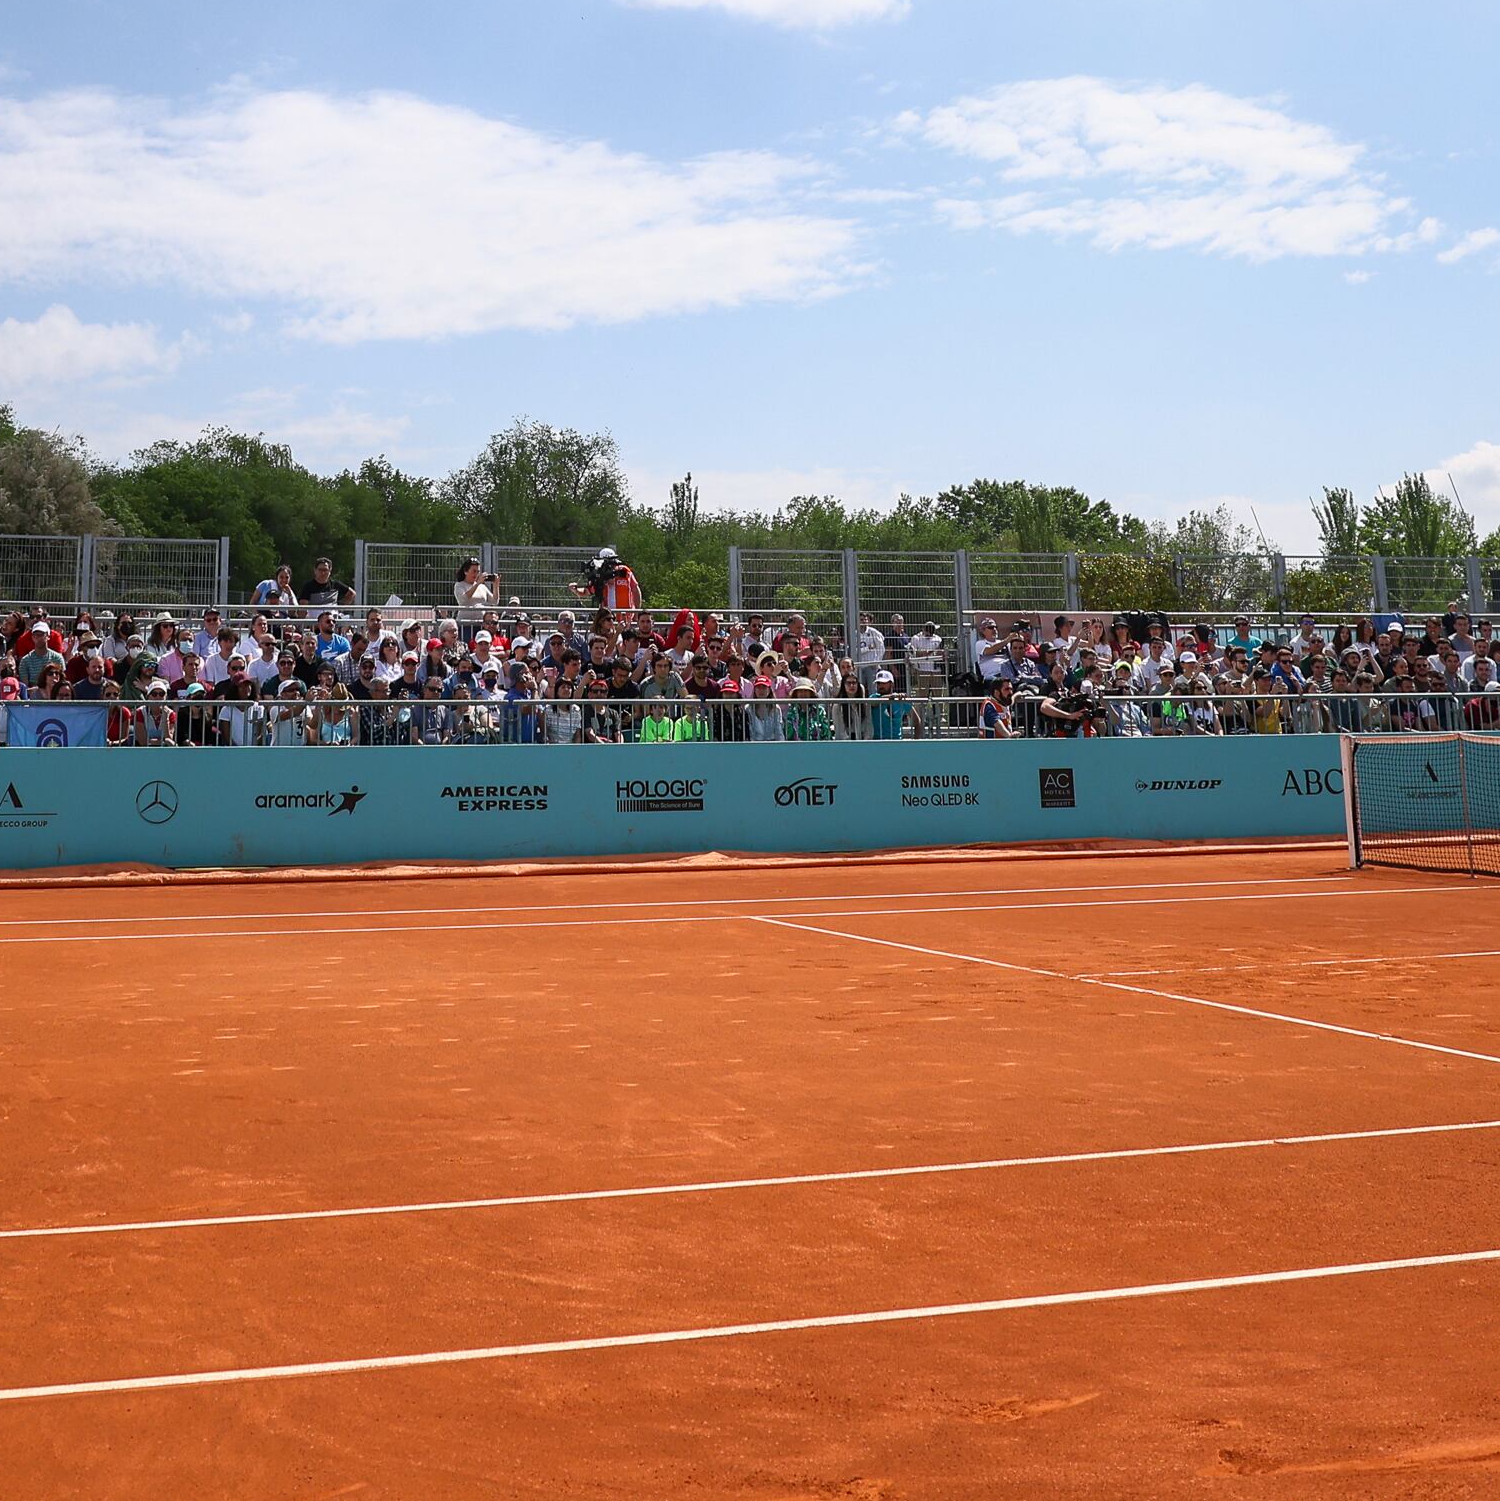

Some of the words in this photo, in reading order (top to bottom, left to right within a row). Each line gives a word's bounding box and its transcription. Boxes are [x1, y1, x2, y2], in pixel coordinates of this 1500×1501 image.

[901, 775, 970, 788] SAMSUNG
[1045, 773, 1070, 788] AC
[1150, 780, 1222, 790] DUNLOP
[1282, 768, 1344, 796] ABC
[440, 785, 548, 798] AMERICAN
[255, 790, 336, 809] aramark
[458, 799, 548, 812] EXPRESS
[902, 794, 929, 807] Neo
[931, 793, 963, 806] QLED
[964, 793, 980, 805] 8K
[21, 820, 48, 828] GROUP
